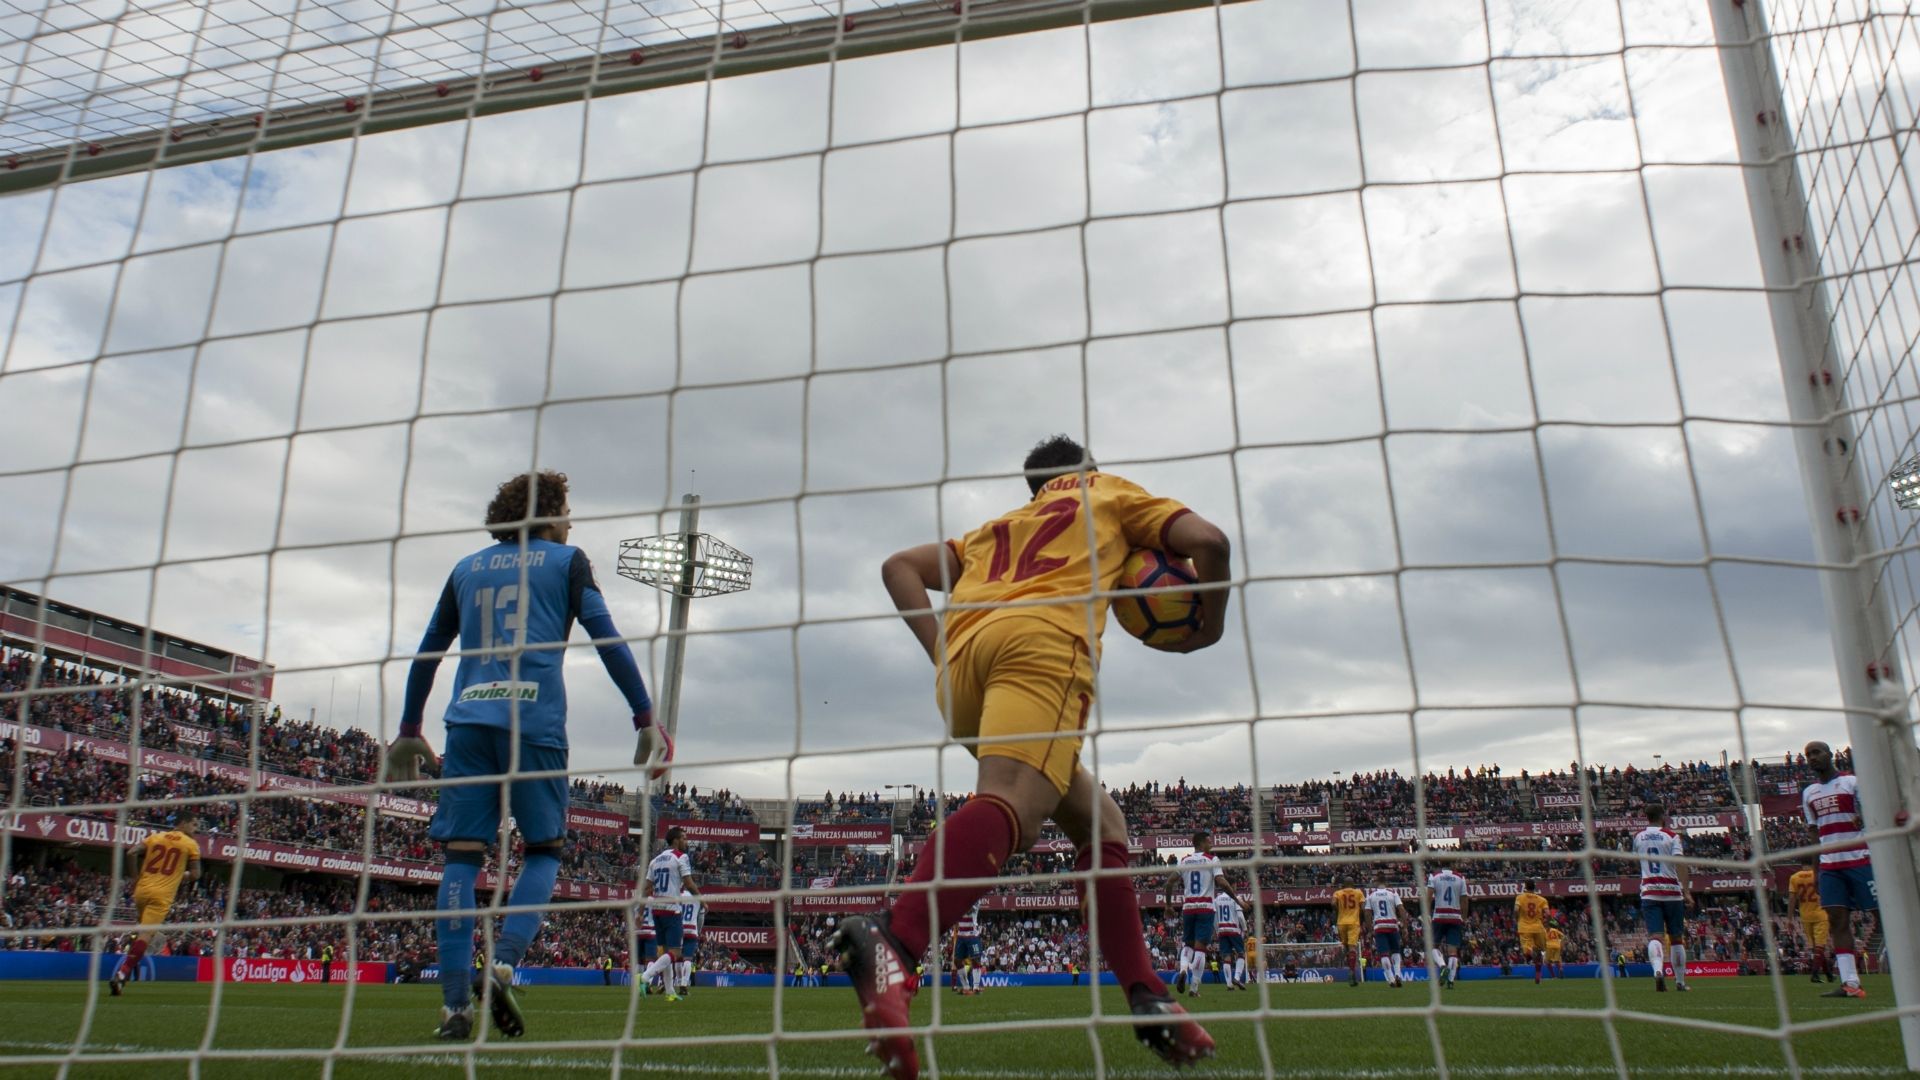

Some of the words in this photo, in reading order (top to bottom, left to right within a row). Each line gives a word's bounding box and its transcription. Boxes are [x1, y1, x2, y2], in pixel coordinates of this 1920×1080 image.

[986, 497, 1080, 583] 12
[475, 585, 528, 665] 13
[1543, 795, 1584, 804] IDEAL
[1283, 806, 1321, 815] IDEAL
[571, 815, 594, 826] CERVEZAS
[66, 819, 109, 842] CAJA
[710, 827, 744, 838] ALHAMBRA
[842, 831, 877, 839] ALHAMBRA
[1341, 829, 1393, 842] GRAFICAS
[1156, 837, 1188, 847] Halcon
[1214, 834, 1248, 845] Halcon
[145, 844, 181, 877] 20
[222, 843, 271, 862] COIRAN
[274, 850, 319, 868] COVIRAN
[322, 855, 364, 872] COVIRAN
[408, 866, 444, 881] COVIRAN
[654, 867, 670, 893] 20
[1190, 870, 1201, 894] 8
[1568, 881, 1621, 893] COVRAN
[805, 896, 838, 905] CERVEZAS
[839, 895, 876, 904] ALHAMBRA
[1015, 896, 1056, 906] CERVEZAS
[1343, 894, 1356, 909] 15
[1443, 886, 1452, 905] 4
[1219, 904, 1230, 922] 19
[1378, 900, 1388, 917] 9
[1527, 902, 1537, 919] 8
[705, 931, 768, 944] WELCOME
[249, 963, 287, 983] LaLiga
[306, 964, 364, 981] Sananer
[875, 943, 887, 995] adidas
[1703, 966, 1737, 974] Santander
